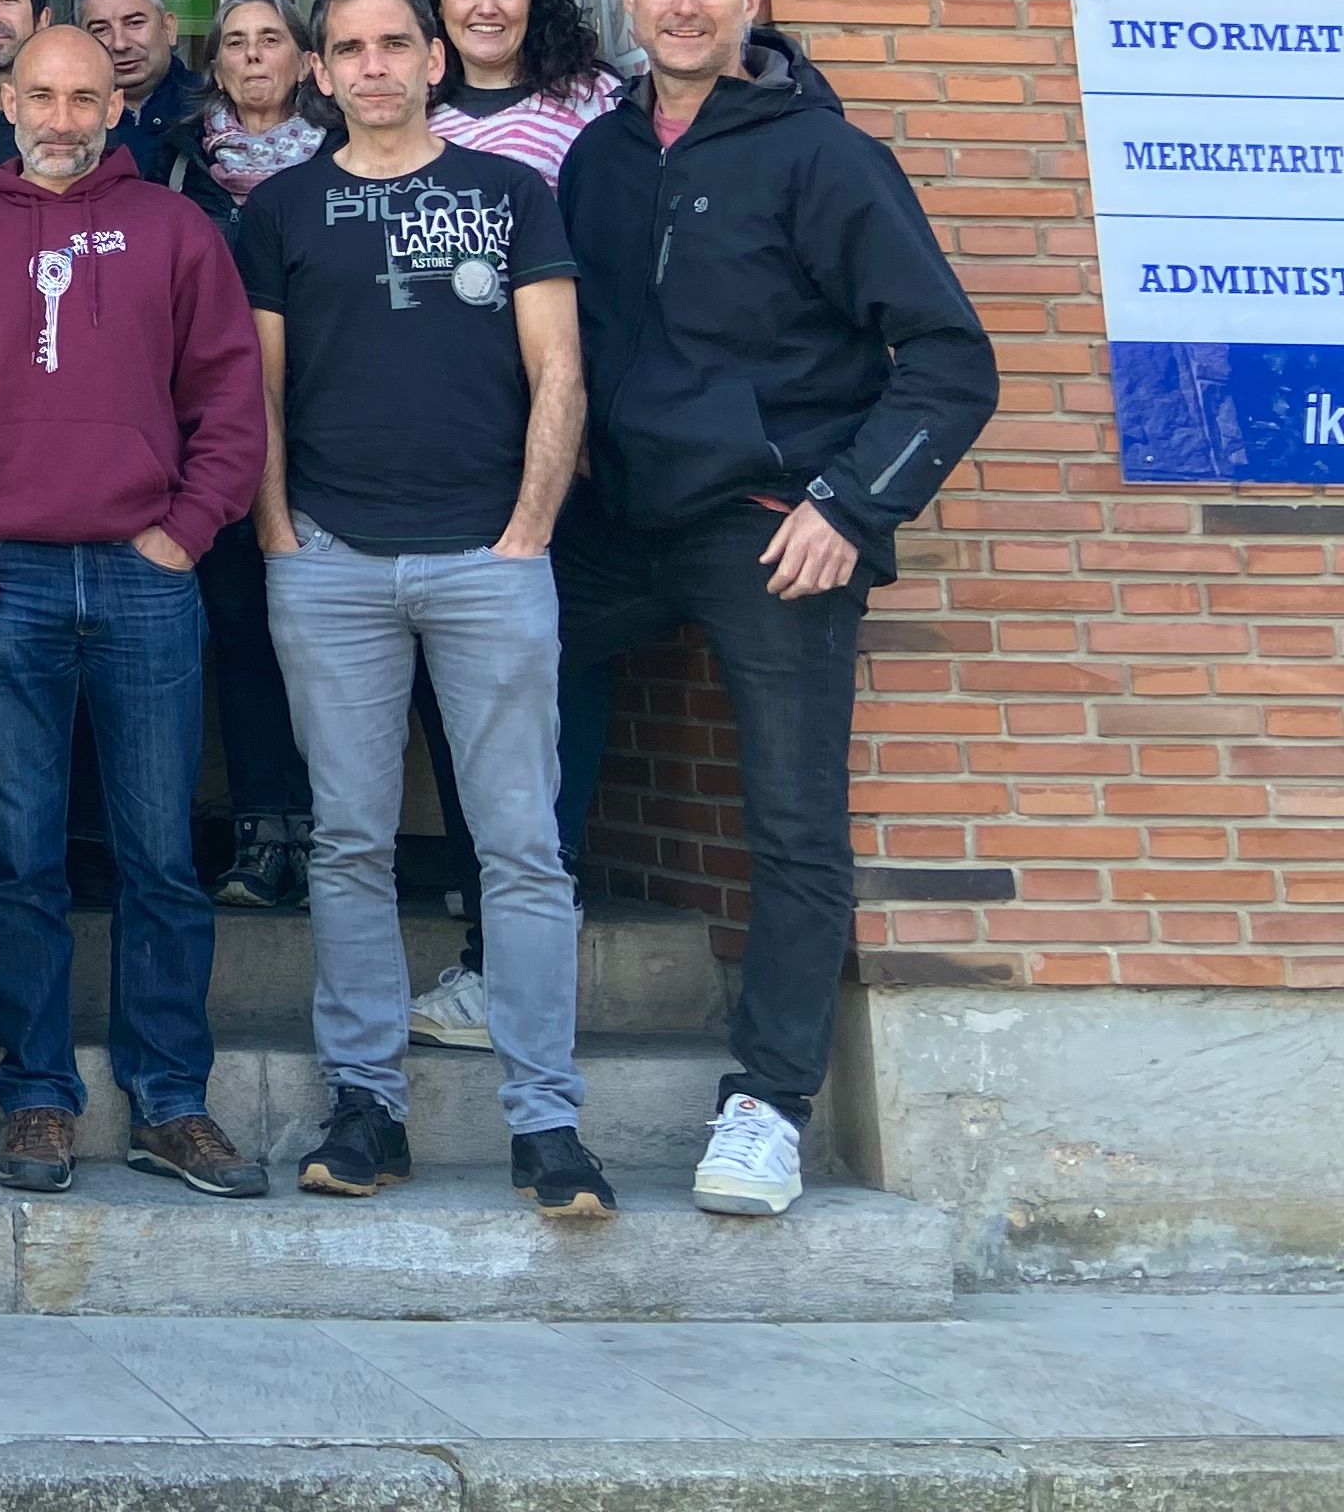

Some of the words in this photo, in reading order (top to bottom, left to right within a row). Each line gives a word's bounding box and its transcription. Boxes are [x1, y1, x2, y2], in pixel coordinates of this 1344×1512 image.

[1110, 20, 1344, 53] INFORMAT
[1123, 142, 1344, 175] MERKATARIT
[326, 176, 446, 201] EUSKAL
[411, 256, 454, 269] ASTORE
